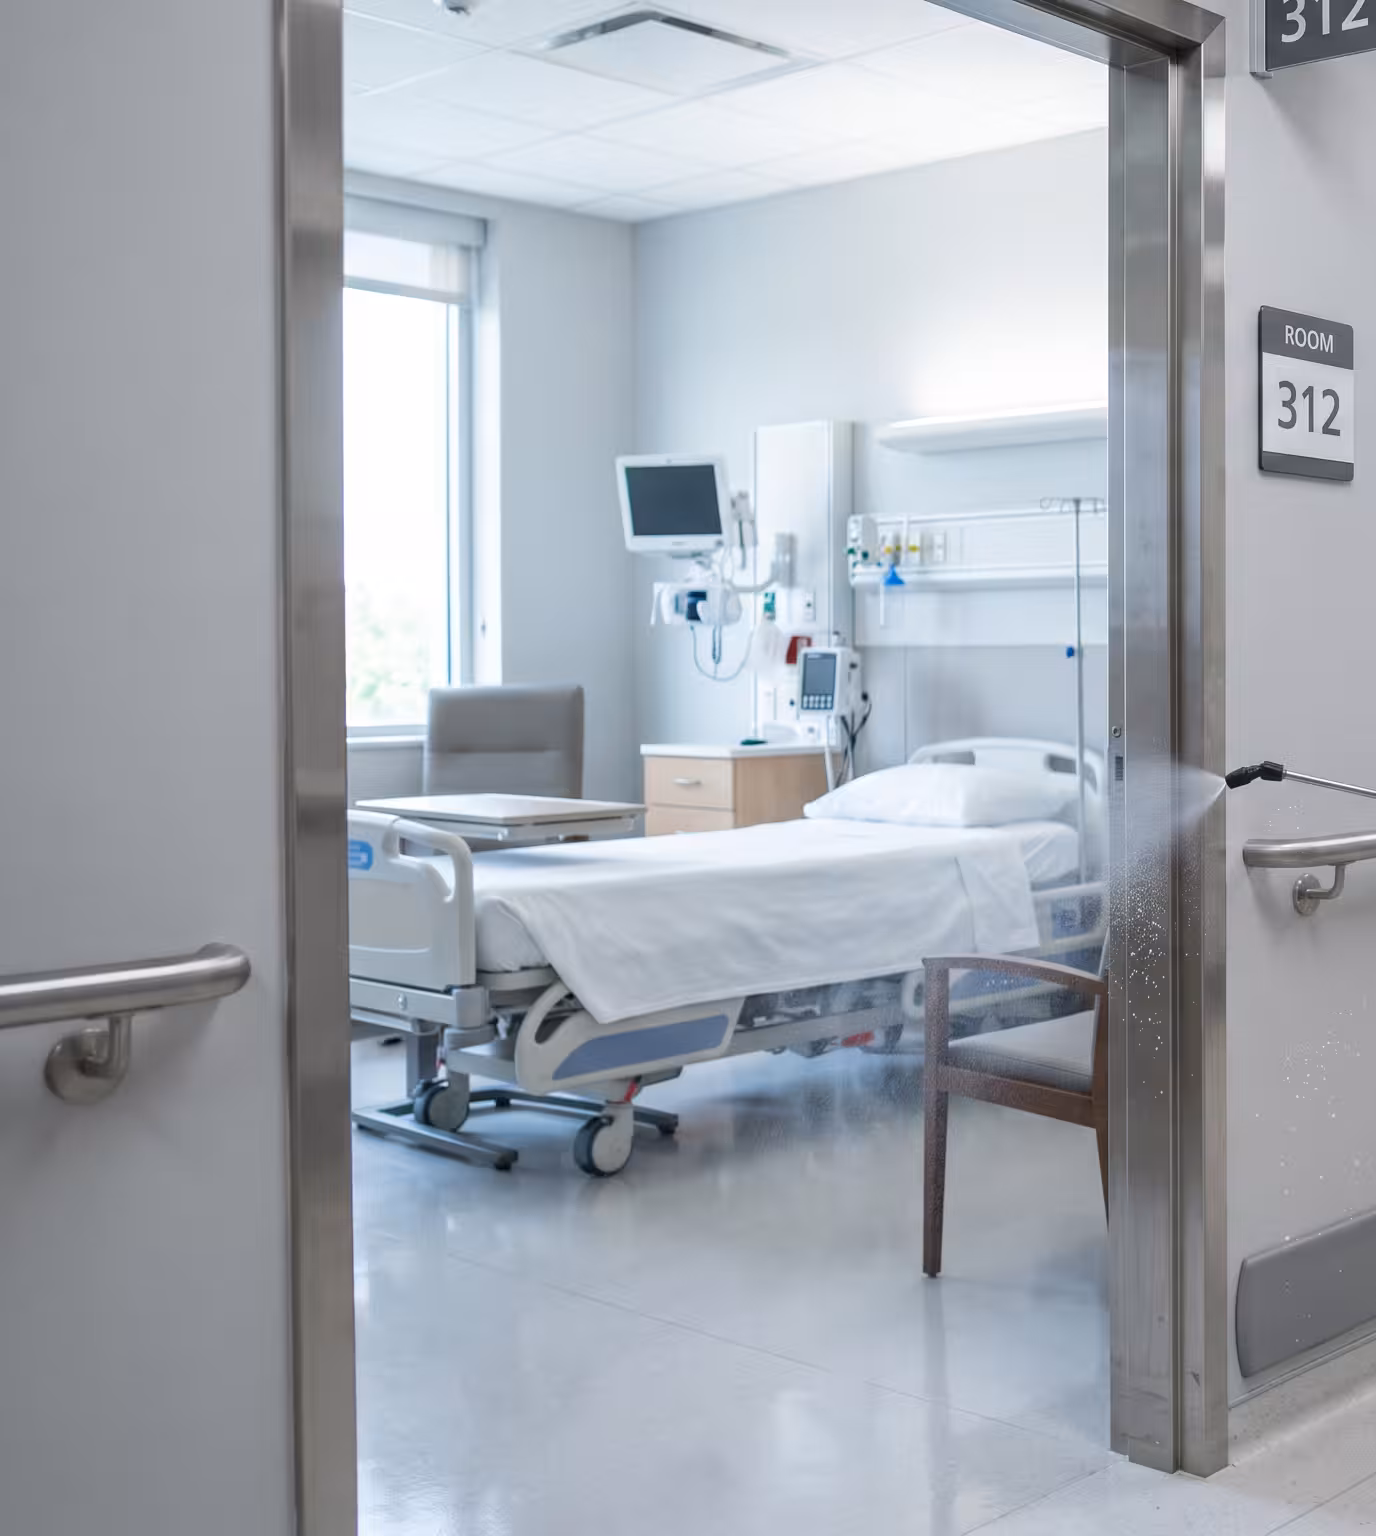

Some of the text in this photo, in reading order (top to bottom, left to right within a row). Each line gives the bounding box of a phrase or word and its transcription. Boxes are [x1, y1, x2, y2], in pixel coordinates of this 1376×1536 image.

[1281, 0, 1369, 43] 312
[1285, 325, 1334, 354] ROOM
[1278, 380, 1341, 437] 312
